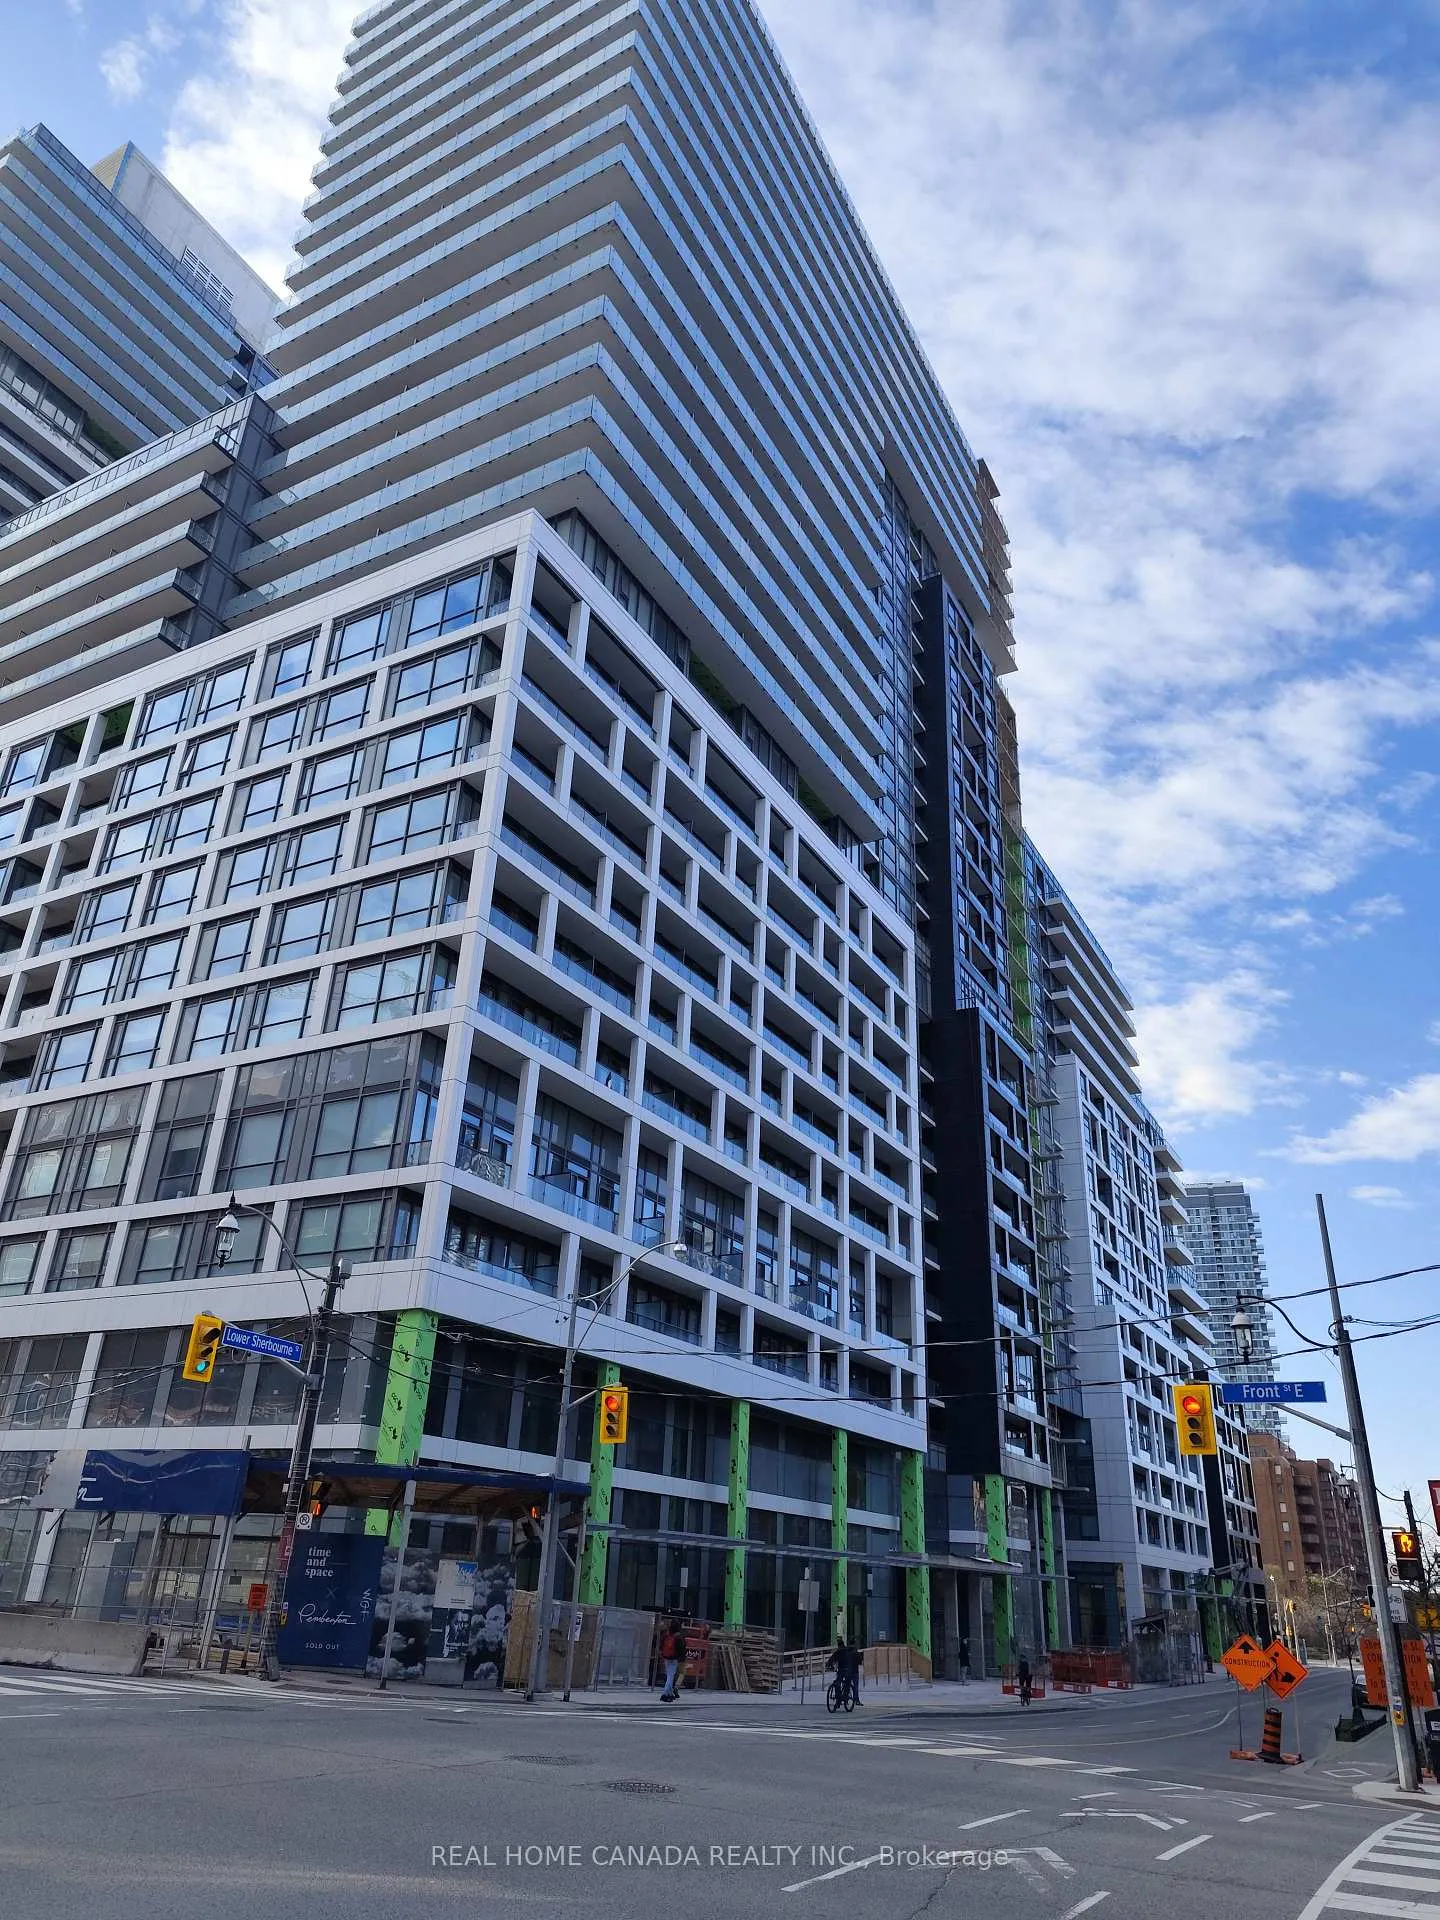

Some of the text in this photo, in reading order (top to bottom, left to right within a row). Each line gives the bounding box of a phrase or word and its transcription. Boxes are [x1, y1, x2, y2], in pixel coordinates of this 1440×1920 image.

[226, 1328, 251, 1345] Lower
[251, 1335, 293, 1356] Sherbourne
[1242, 1383, 1304, 1399] Front St E
[308, 1546, 332, 1557] time
[306, 1557, 326, 1567] and
[304, 1567, 334, 1579] space
[305, 1641, 340, 1651] SOLD OUT
[1224, 1657, 1271, 1668] CONSTRUCTION
